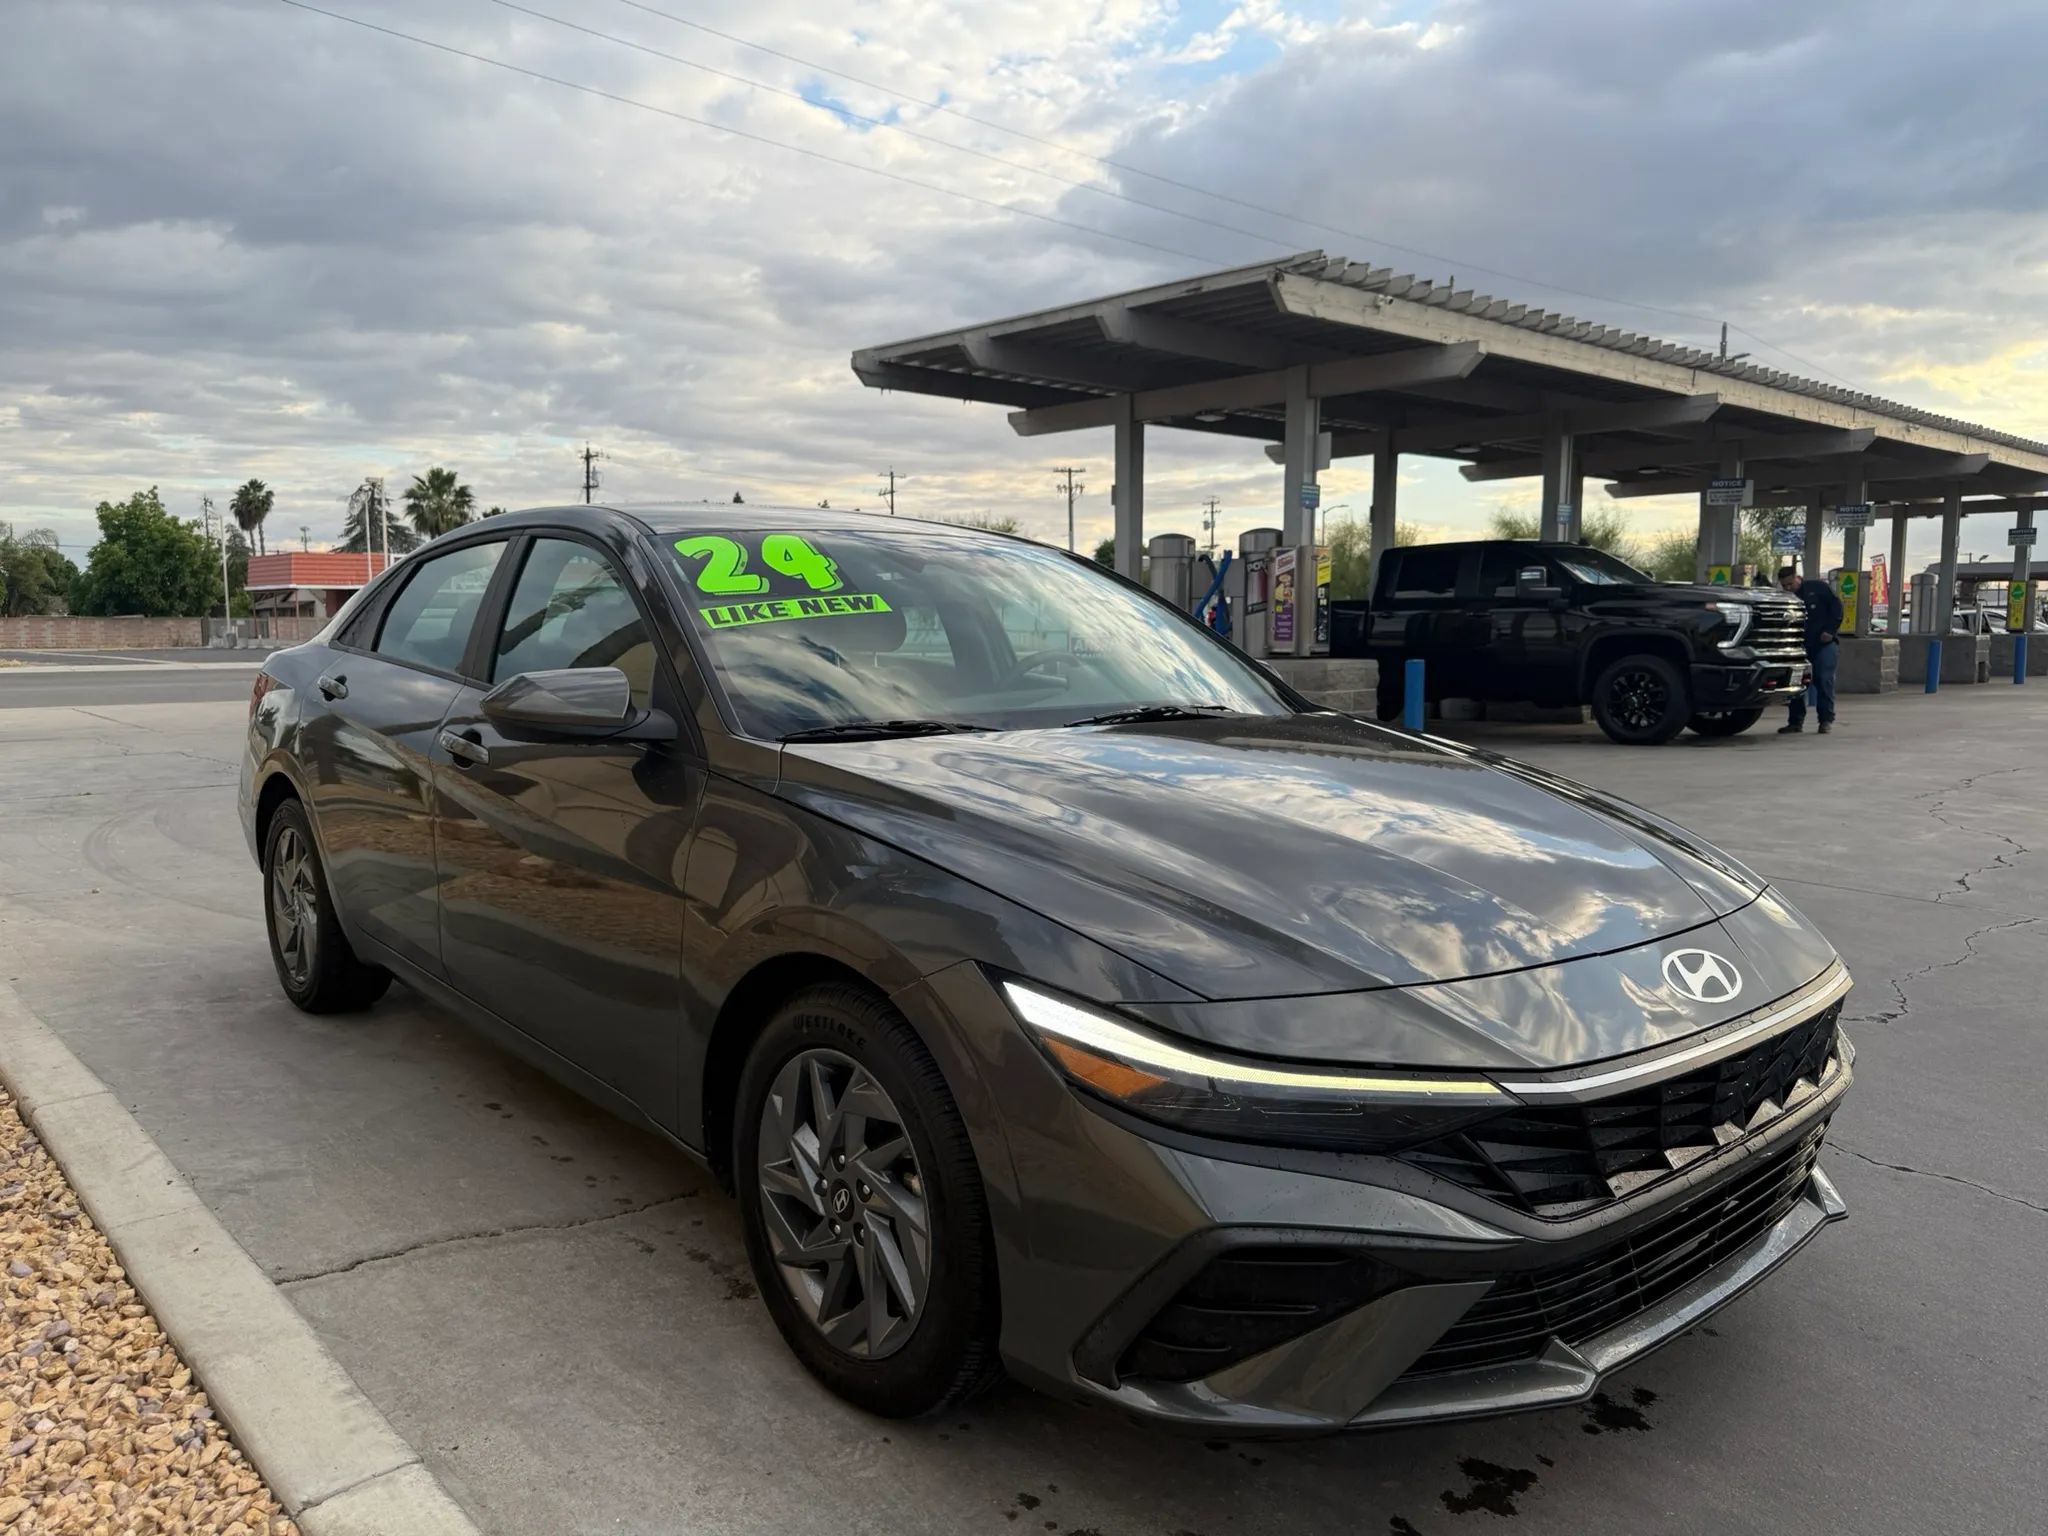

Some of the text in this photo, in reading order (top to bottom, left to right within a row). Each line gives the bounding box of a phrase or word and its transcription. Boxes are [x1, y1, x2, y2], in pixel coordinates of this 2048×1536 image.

[1711, 480, 1744, 488] NOTICE
[1839, 505, 1867, 513] NOTICE
[674, 533, 843, 595] 24
[708, 596, 877, 625] LIKE NEW
